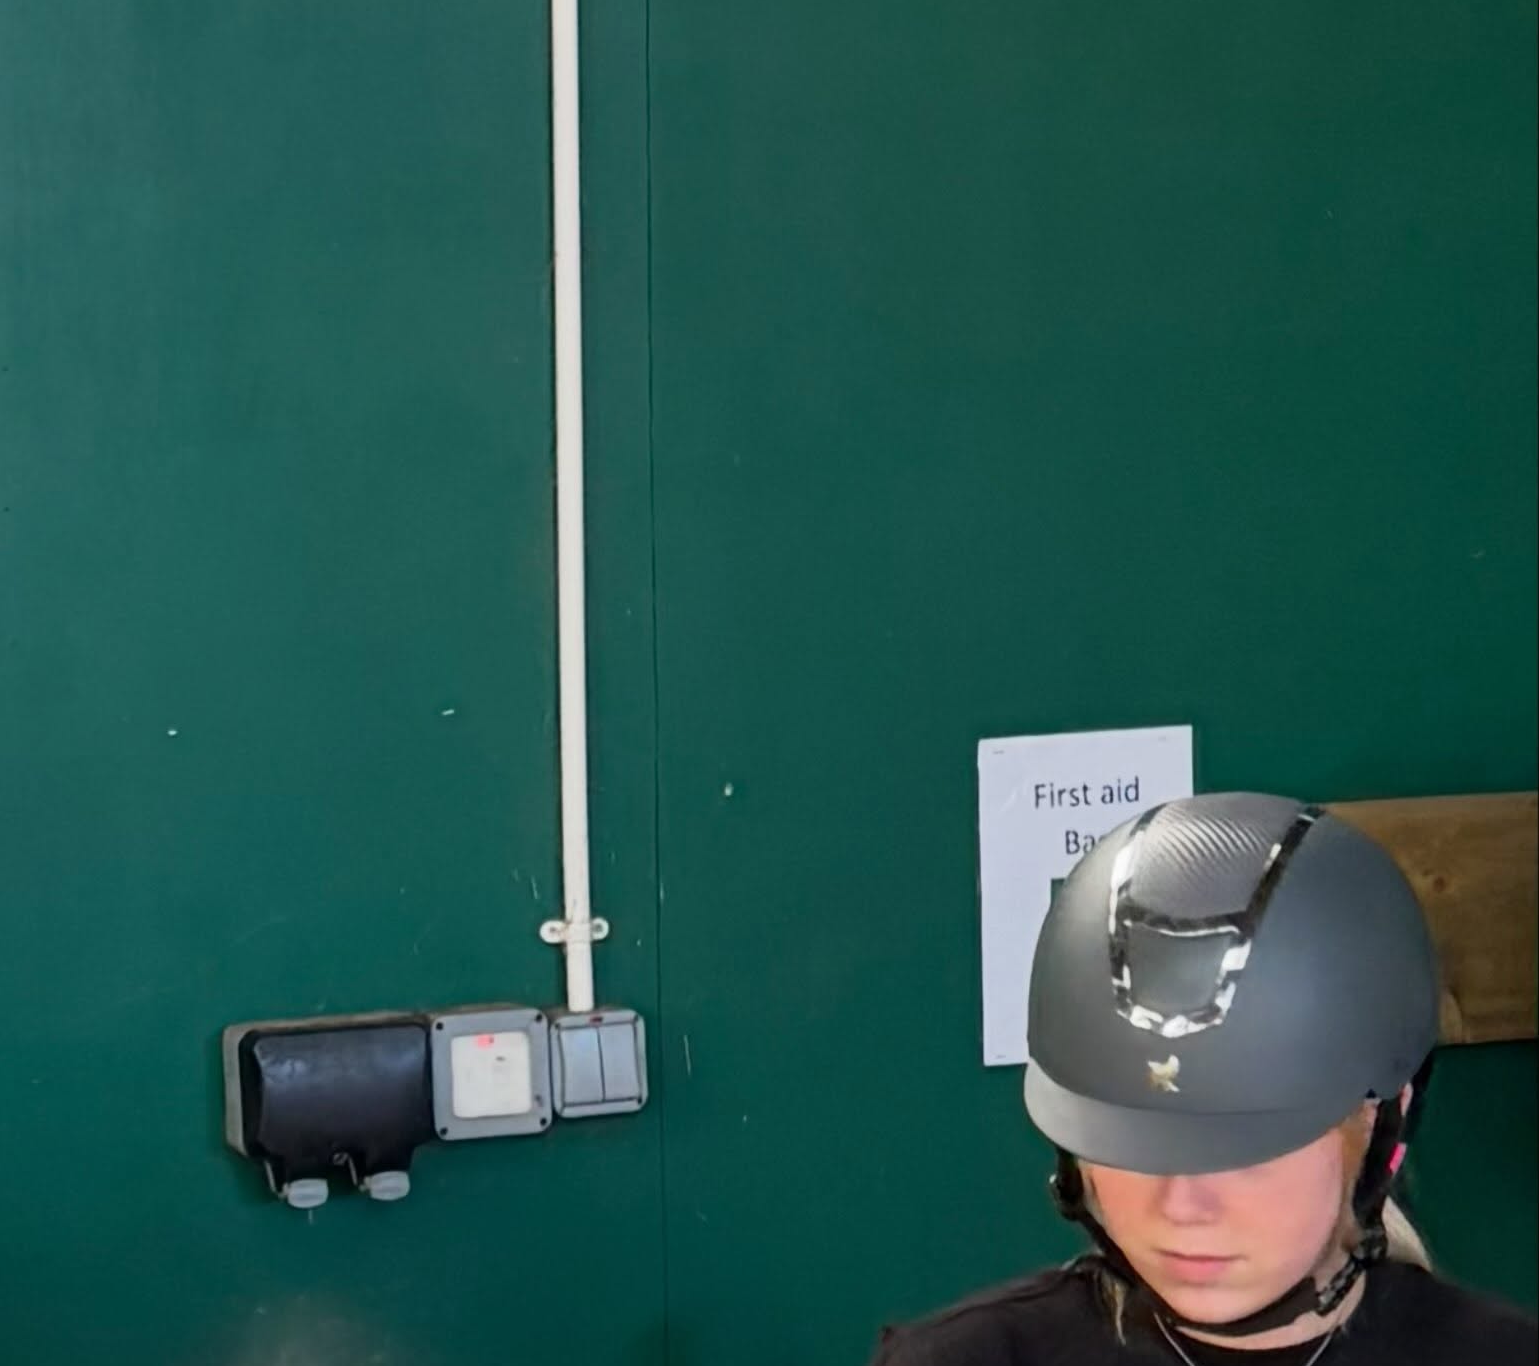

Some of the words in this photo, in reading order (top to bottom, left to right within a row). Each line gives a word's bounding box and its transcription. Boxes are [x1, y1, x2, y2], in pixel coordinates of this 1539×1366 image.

[1034, 782, 1093, 810] First
[1100, 776, 1140, 805] aid
[1065, 829, 1107, 855] Ba
